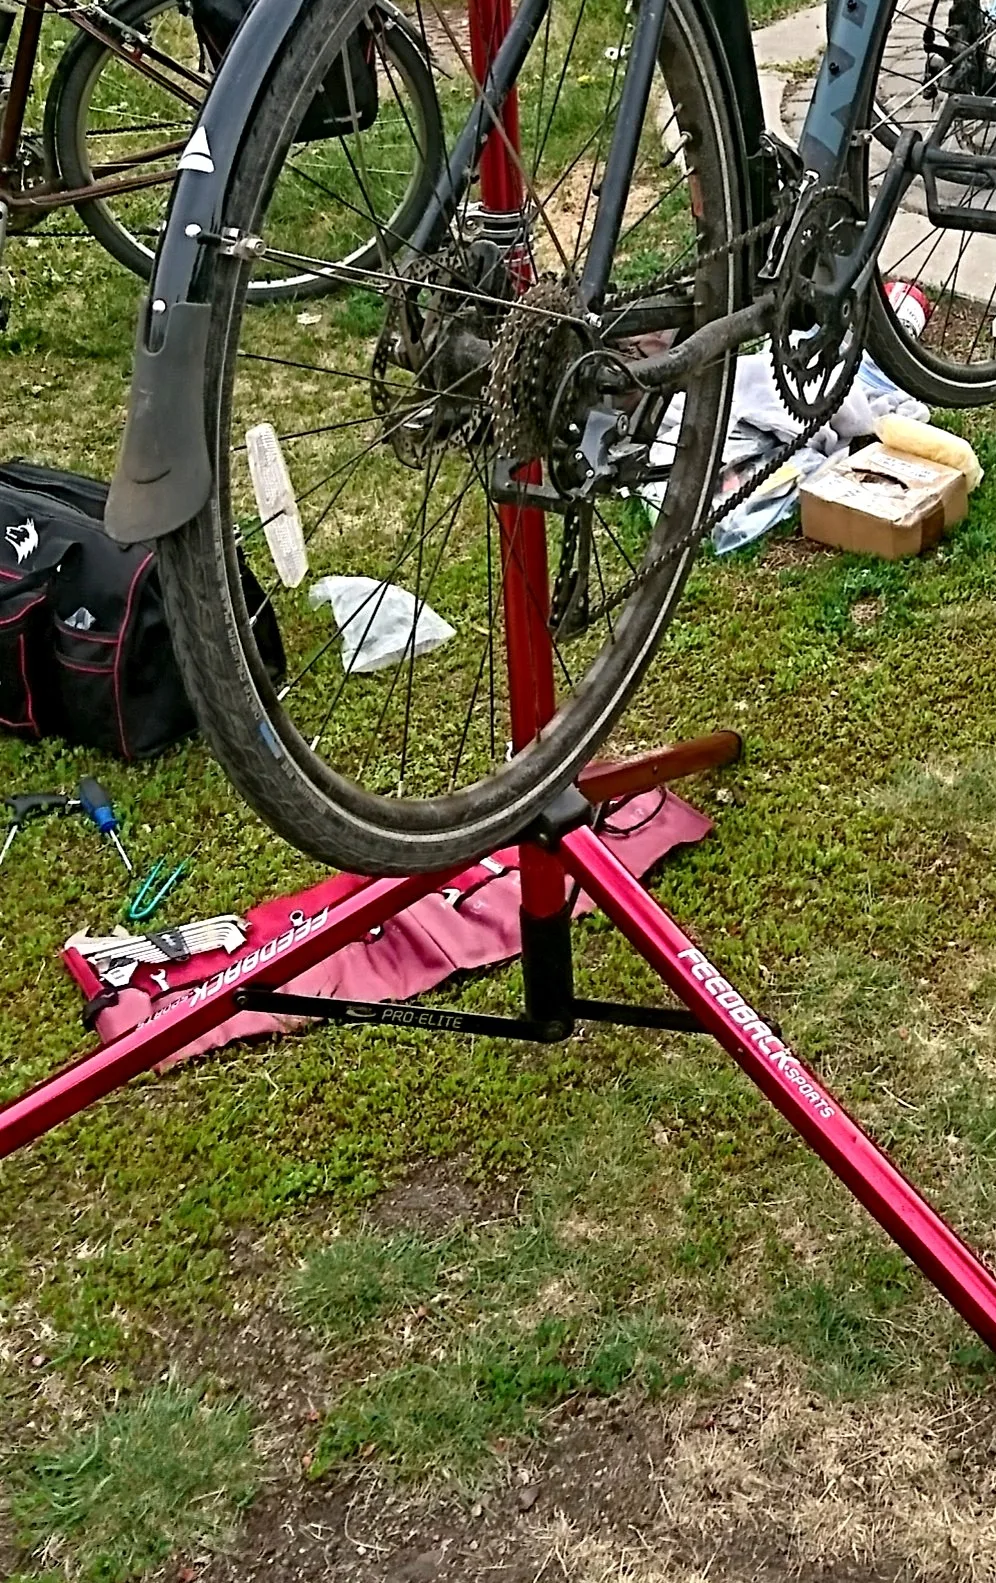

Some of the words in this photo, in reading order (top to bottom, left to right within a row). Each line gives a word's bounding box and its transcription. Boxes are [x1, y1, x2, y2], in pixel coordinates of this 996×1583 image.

[189, 906, 330, 1008] FEEDBACK
[677, 947, 801, 1071] FEEDBACK
[785, 1069, 835, 1119] SPORTS
